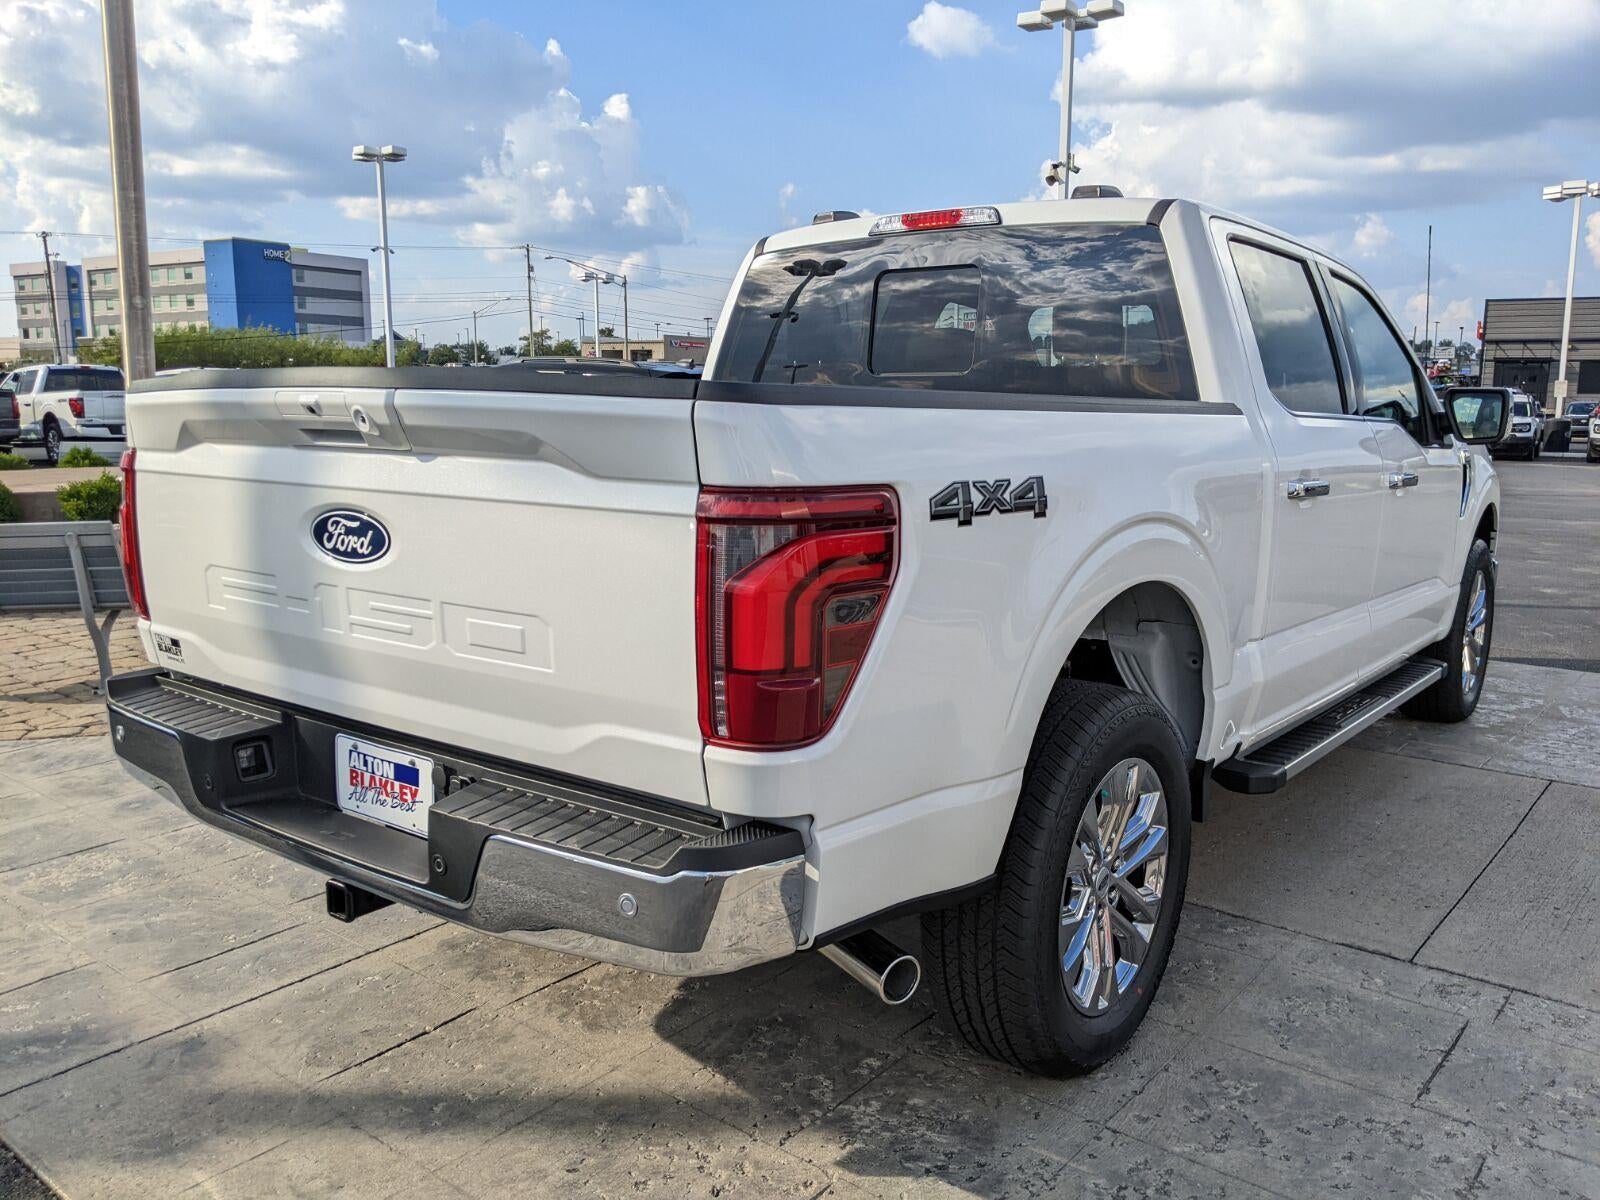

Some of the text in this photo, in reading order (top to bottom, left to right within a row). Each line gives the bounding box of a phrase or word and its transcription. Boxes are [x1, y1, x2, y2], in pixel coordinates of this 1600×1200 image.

[323, 517, 373, 555] Ford
[205, 564, 555, 673] F-150
[349, 751, 395, 780] ALTON
[348, 785, 424, 813] All The Best
[349, 768, 420, 803] BLAKLEY
